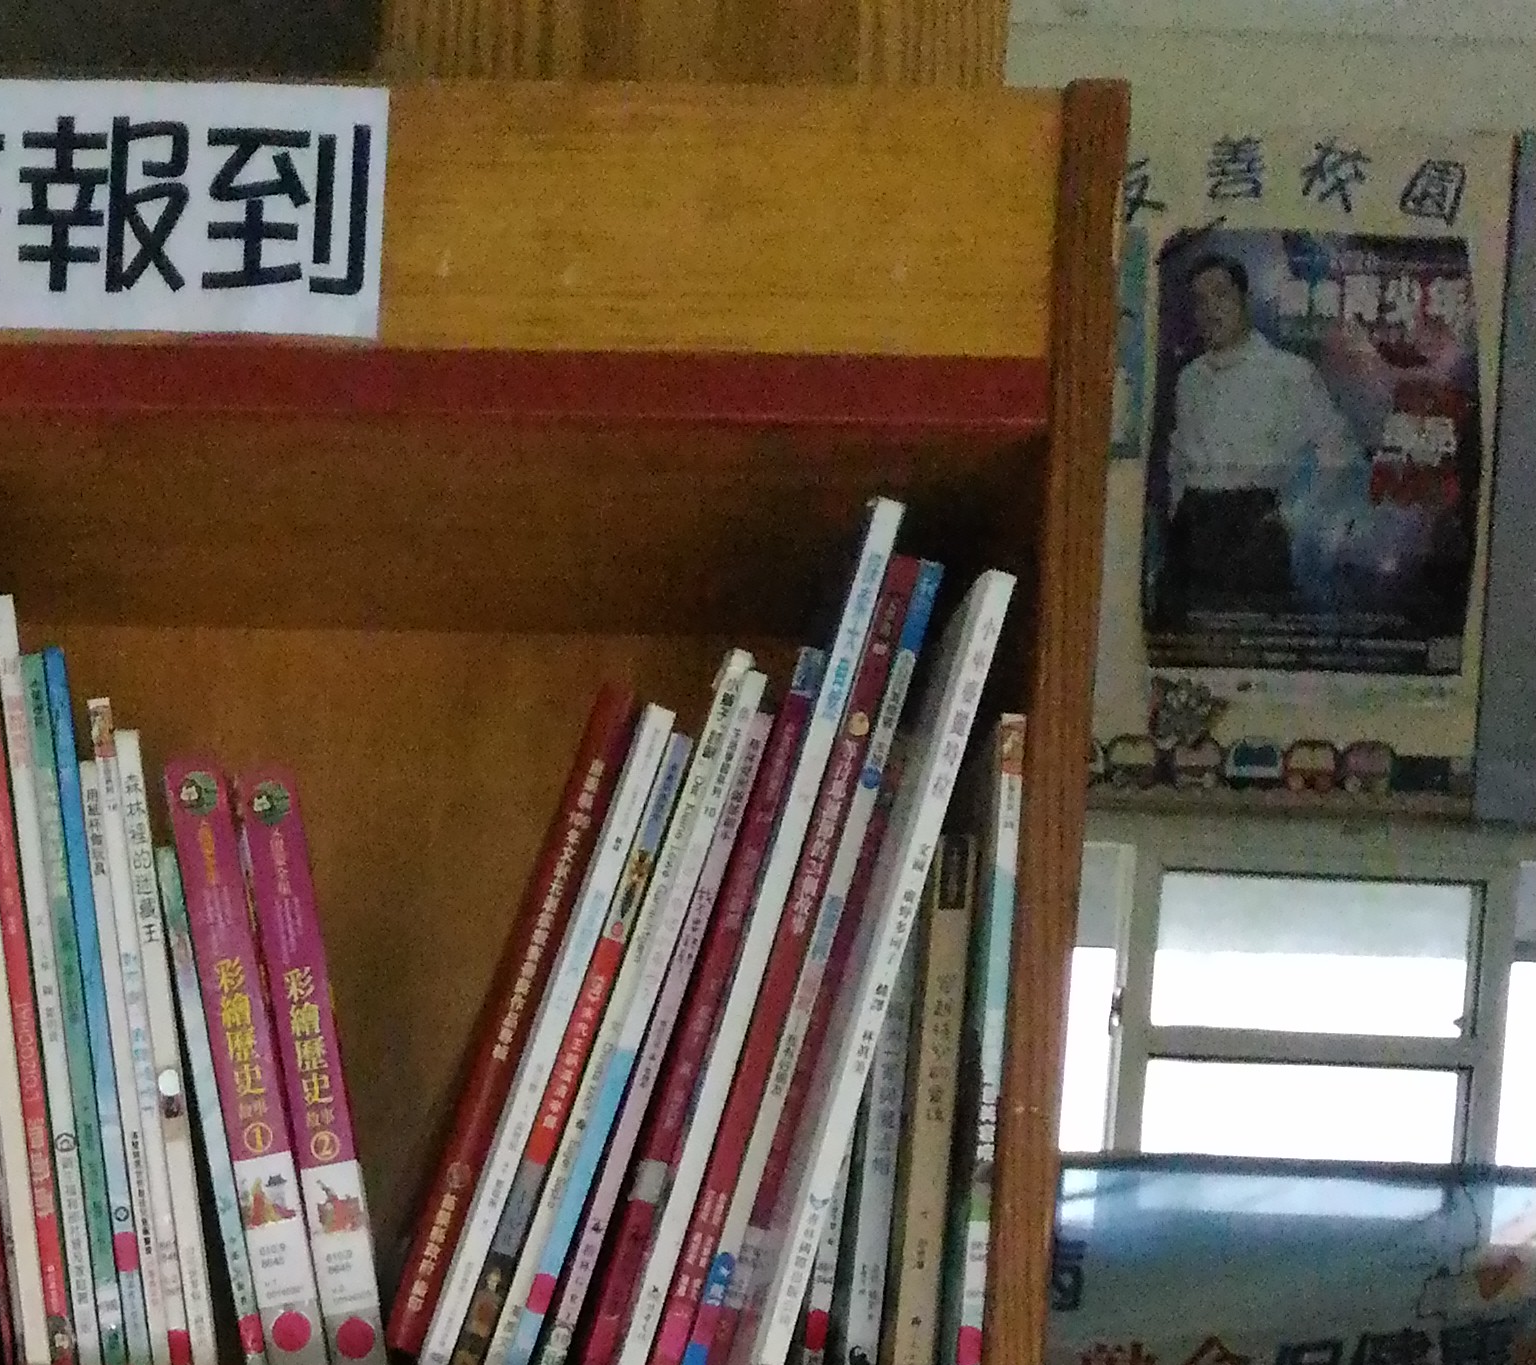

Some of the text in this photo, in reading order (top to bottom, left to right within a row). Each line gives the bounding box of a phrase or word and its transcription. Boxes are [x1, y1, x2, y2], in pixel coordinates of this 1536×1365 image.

[215, 956, 265, 1098] 彩繪歷史
[283, 966, 334, 1104] 彩繪歷史
